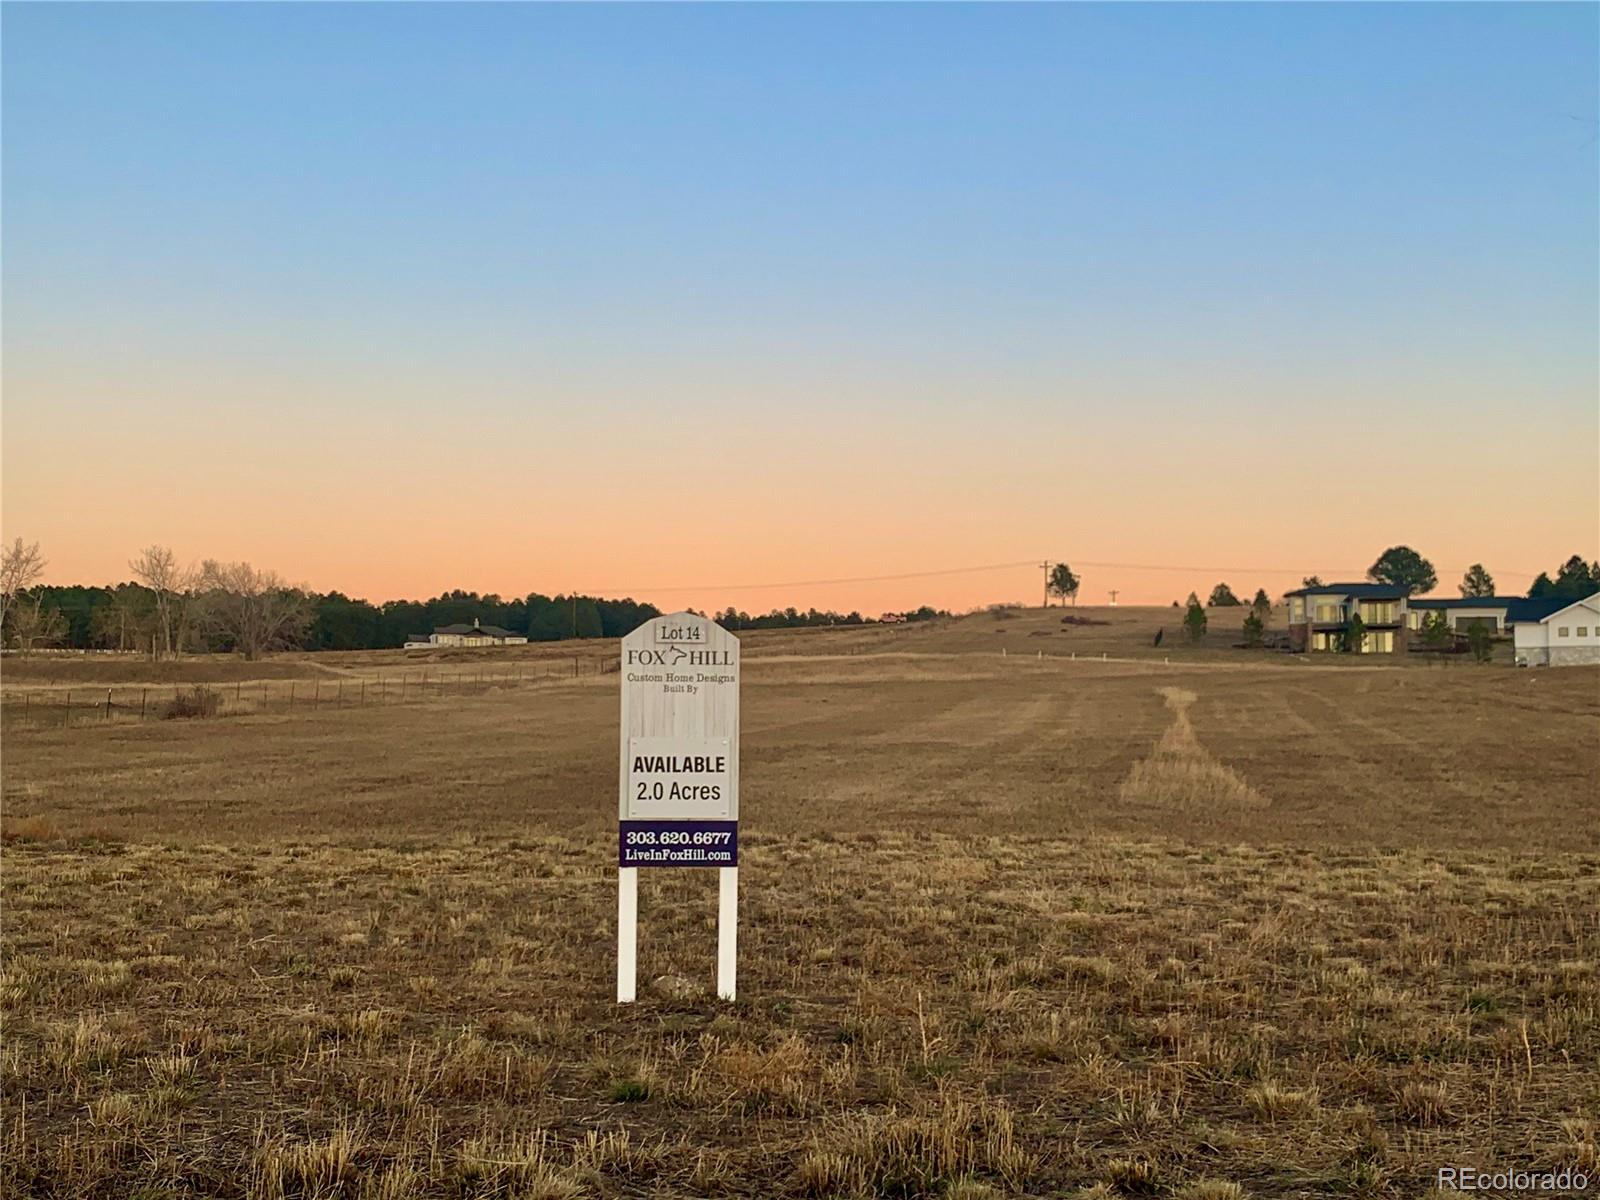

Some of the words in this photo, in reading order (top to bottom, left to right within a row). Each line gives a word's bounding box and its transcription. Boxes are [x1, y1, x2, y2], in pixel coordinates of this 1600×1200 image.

[661, 626, 683, 640] Lot
[687, 626, 700, 640] 14
[627, 650, 667, 665] FOX
[689, 650, 734, 665] HILL
[627, 673, 663, 682] Custom
[666, 673, 694, 682] Home
[696, 673, 735, 684] Designs
[663, 685, 685, 693] Built
[686, 685, 698, 694] By
[633, 756, 725, 773] AVAILABLE
[637, 782, 664, 800] 2.0
[669, 781, 721, 800] Acres
[626, 831, 732, 845] 303.620.6677
[625, 849, 731, 861] LiveInFoxHill.com
